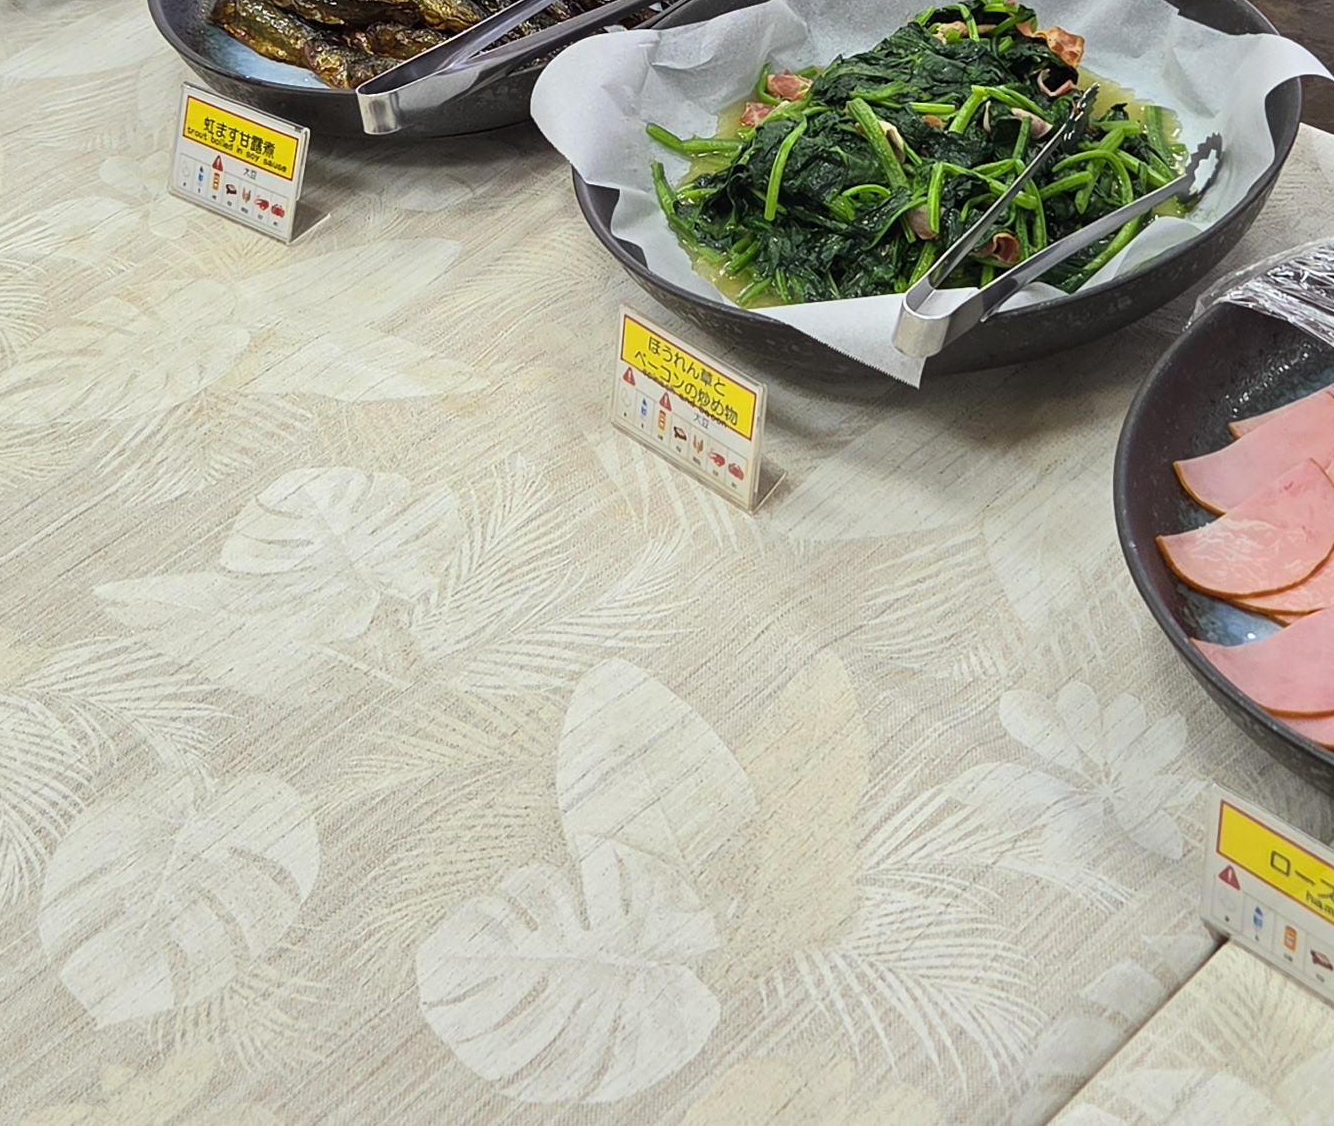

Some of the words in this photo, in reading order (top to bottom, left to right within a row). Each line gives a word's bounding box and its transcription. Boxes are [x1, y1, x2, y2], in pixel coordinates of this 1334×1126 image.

[203, 117, 275, 159] 虹ます甘露煮
[634, 351, 738, 426] ベーコンの炒め物
[648, 336, 726, 397] ほうれん草と
